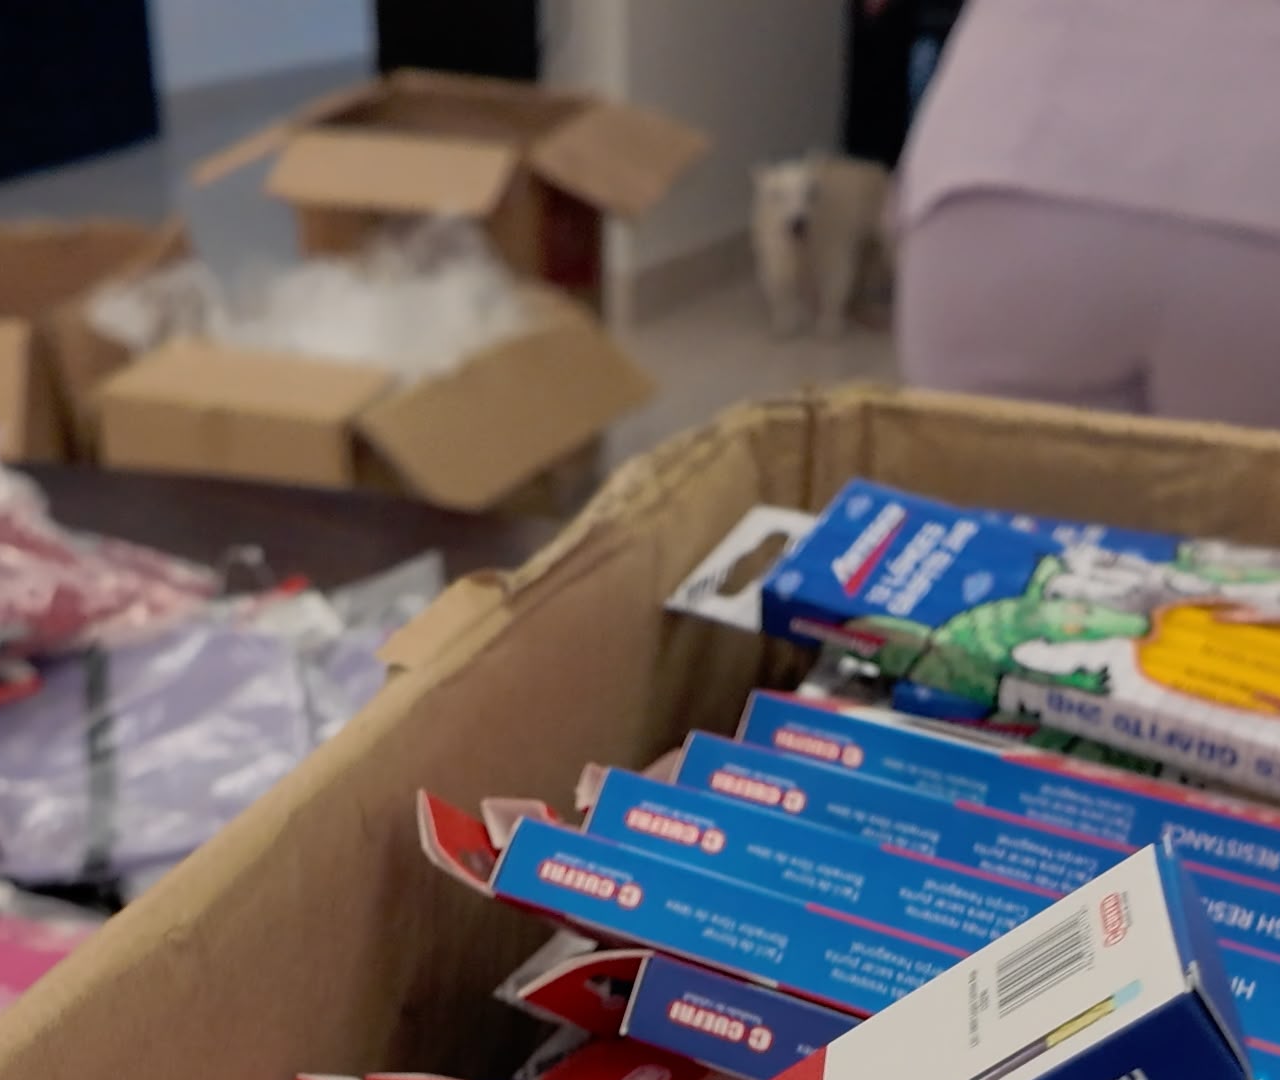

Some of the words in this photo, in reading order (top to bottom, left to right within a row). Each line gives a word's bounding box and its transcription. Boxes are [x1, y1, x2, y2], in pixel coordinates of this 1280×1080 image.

[623, 806, 701, 847] CUEFRI
[537, 858, 616, 901] CUEFRI
[1197, 894, 1255, 930] RESI
[1228, 975, 1257, 1000] HI
[666, 998, 748, 1043] CUEFRI
